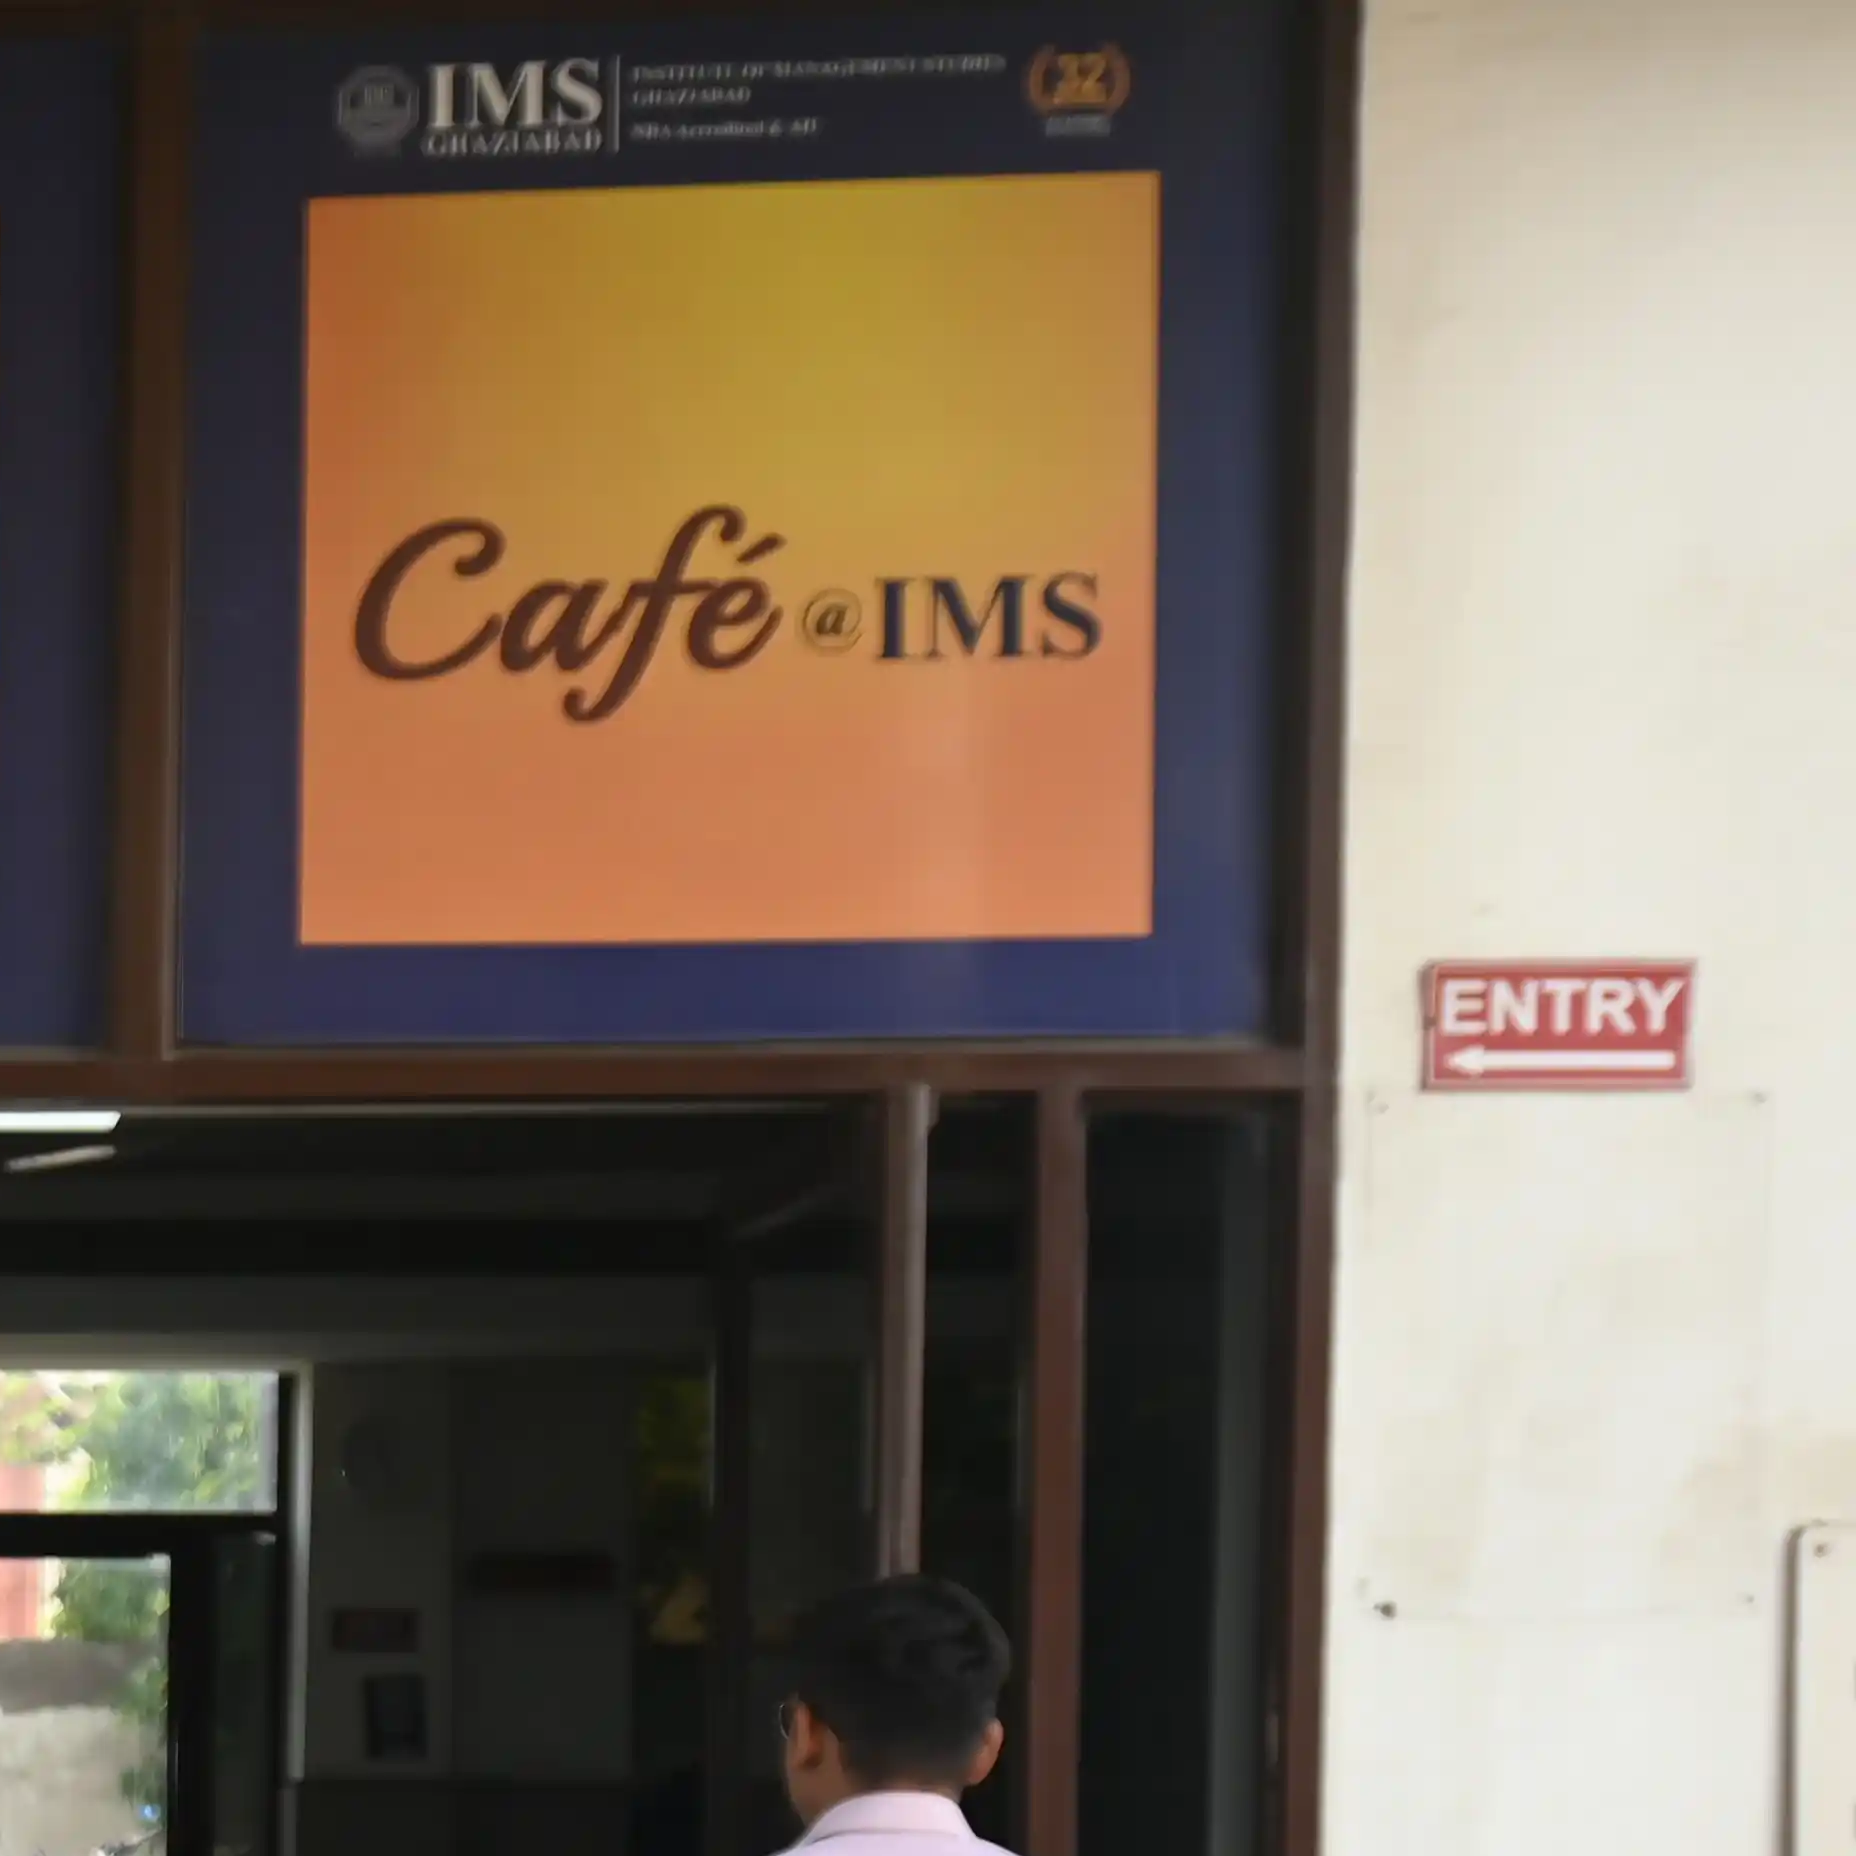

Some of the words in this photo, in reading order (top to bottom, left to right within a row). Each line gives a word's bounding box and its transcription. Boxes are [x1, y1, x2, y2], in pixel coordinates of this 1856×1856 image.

[426, 58, 603, 128] IMS
[1056, 53, 1106, 100] 32
[422, 128, 603, 157] GHAZIABAD
[354, 504, 787, 724] Café
[803, 588, 864, 652] @
[875, 571, 1102, 661] IMS
[1441, 977, 1685, 1035] ENTRY
